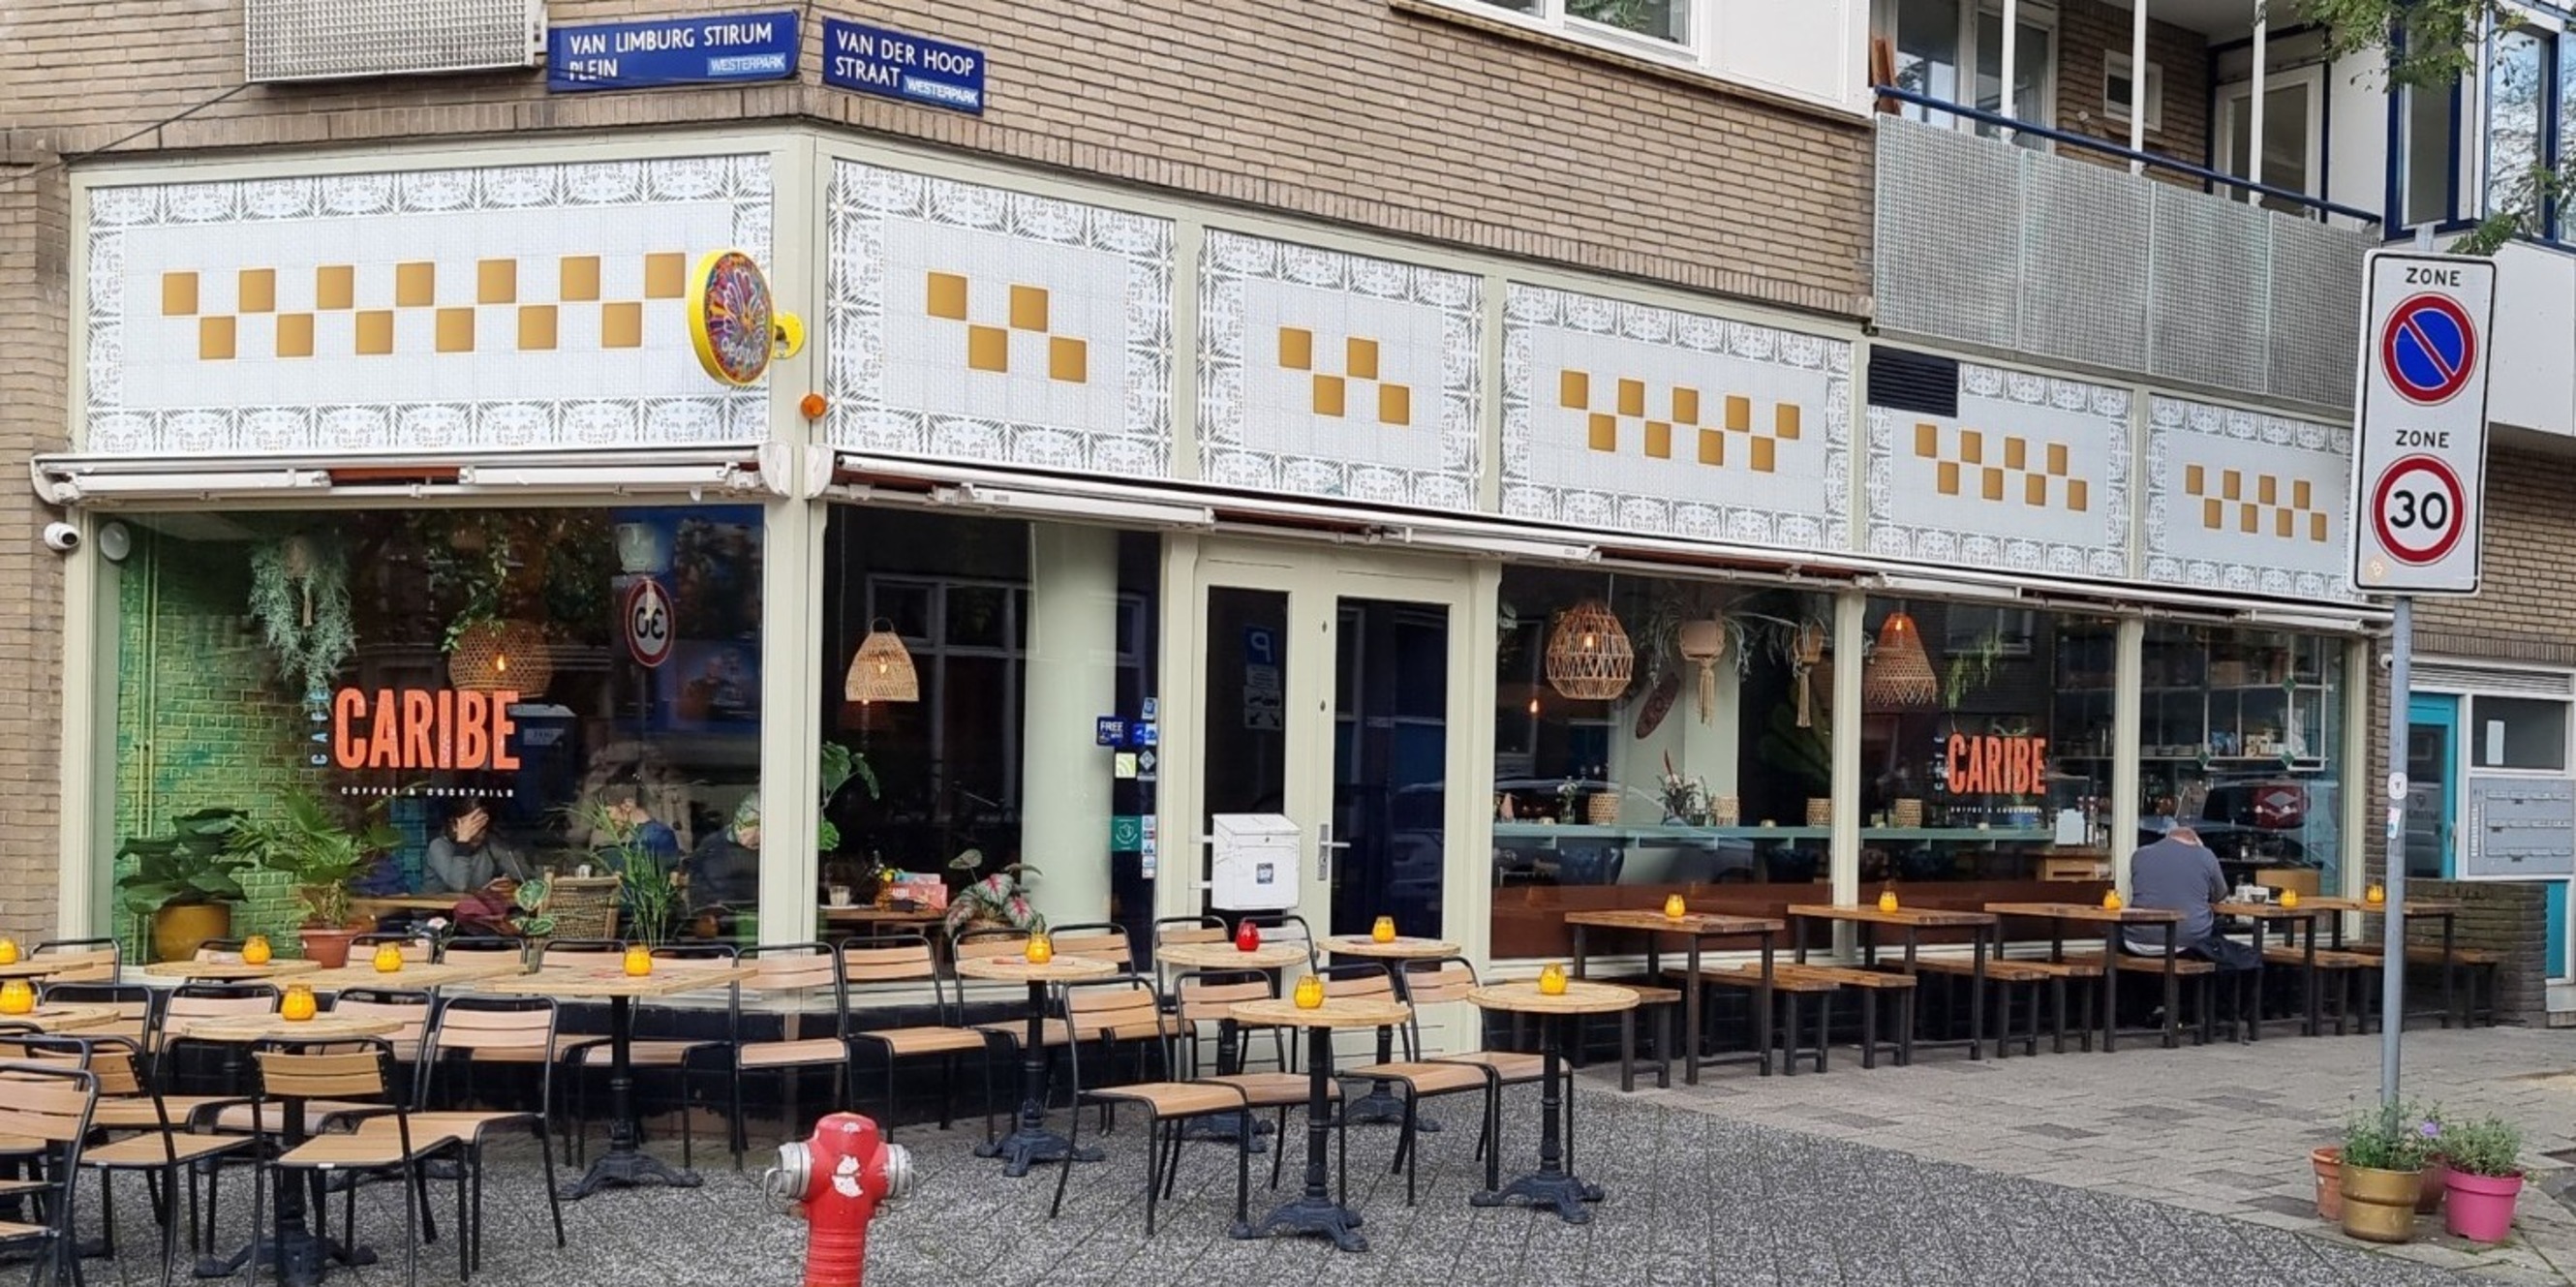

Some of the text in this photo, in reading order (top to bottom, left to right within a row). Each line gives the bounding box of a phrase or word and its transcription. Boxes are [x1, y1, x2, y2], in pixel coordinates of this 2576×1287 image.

[570, 22, 772, 54] VAN LIMBURG STIRUM
[837, 29, 974, 77] VAN DER HOOP
[569, 58, 618, 81] PLEIN
[710, 55, 785, 73] WESTERPARK
[835, 56, 901, 87] STRAAT
[905, 77, 978, 107] WESTERPARK
[2406, 267, 2461, 287] ZONE
[2396, 430, 2450, 448] ZONE
[2390, 490, 2447, 530] 30
[335, 688, 520, 770] CARIBE
[1099, 720, 1123, 731] FREE
[1947, 733, 2046, 794] CARIBE
[341, 786, 397, 796] COFFEE
[427, 787, 514, 798] COCKTAILS
